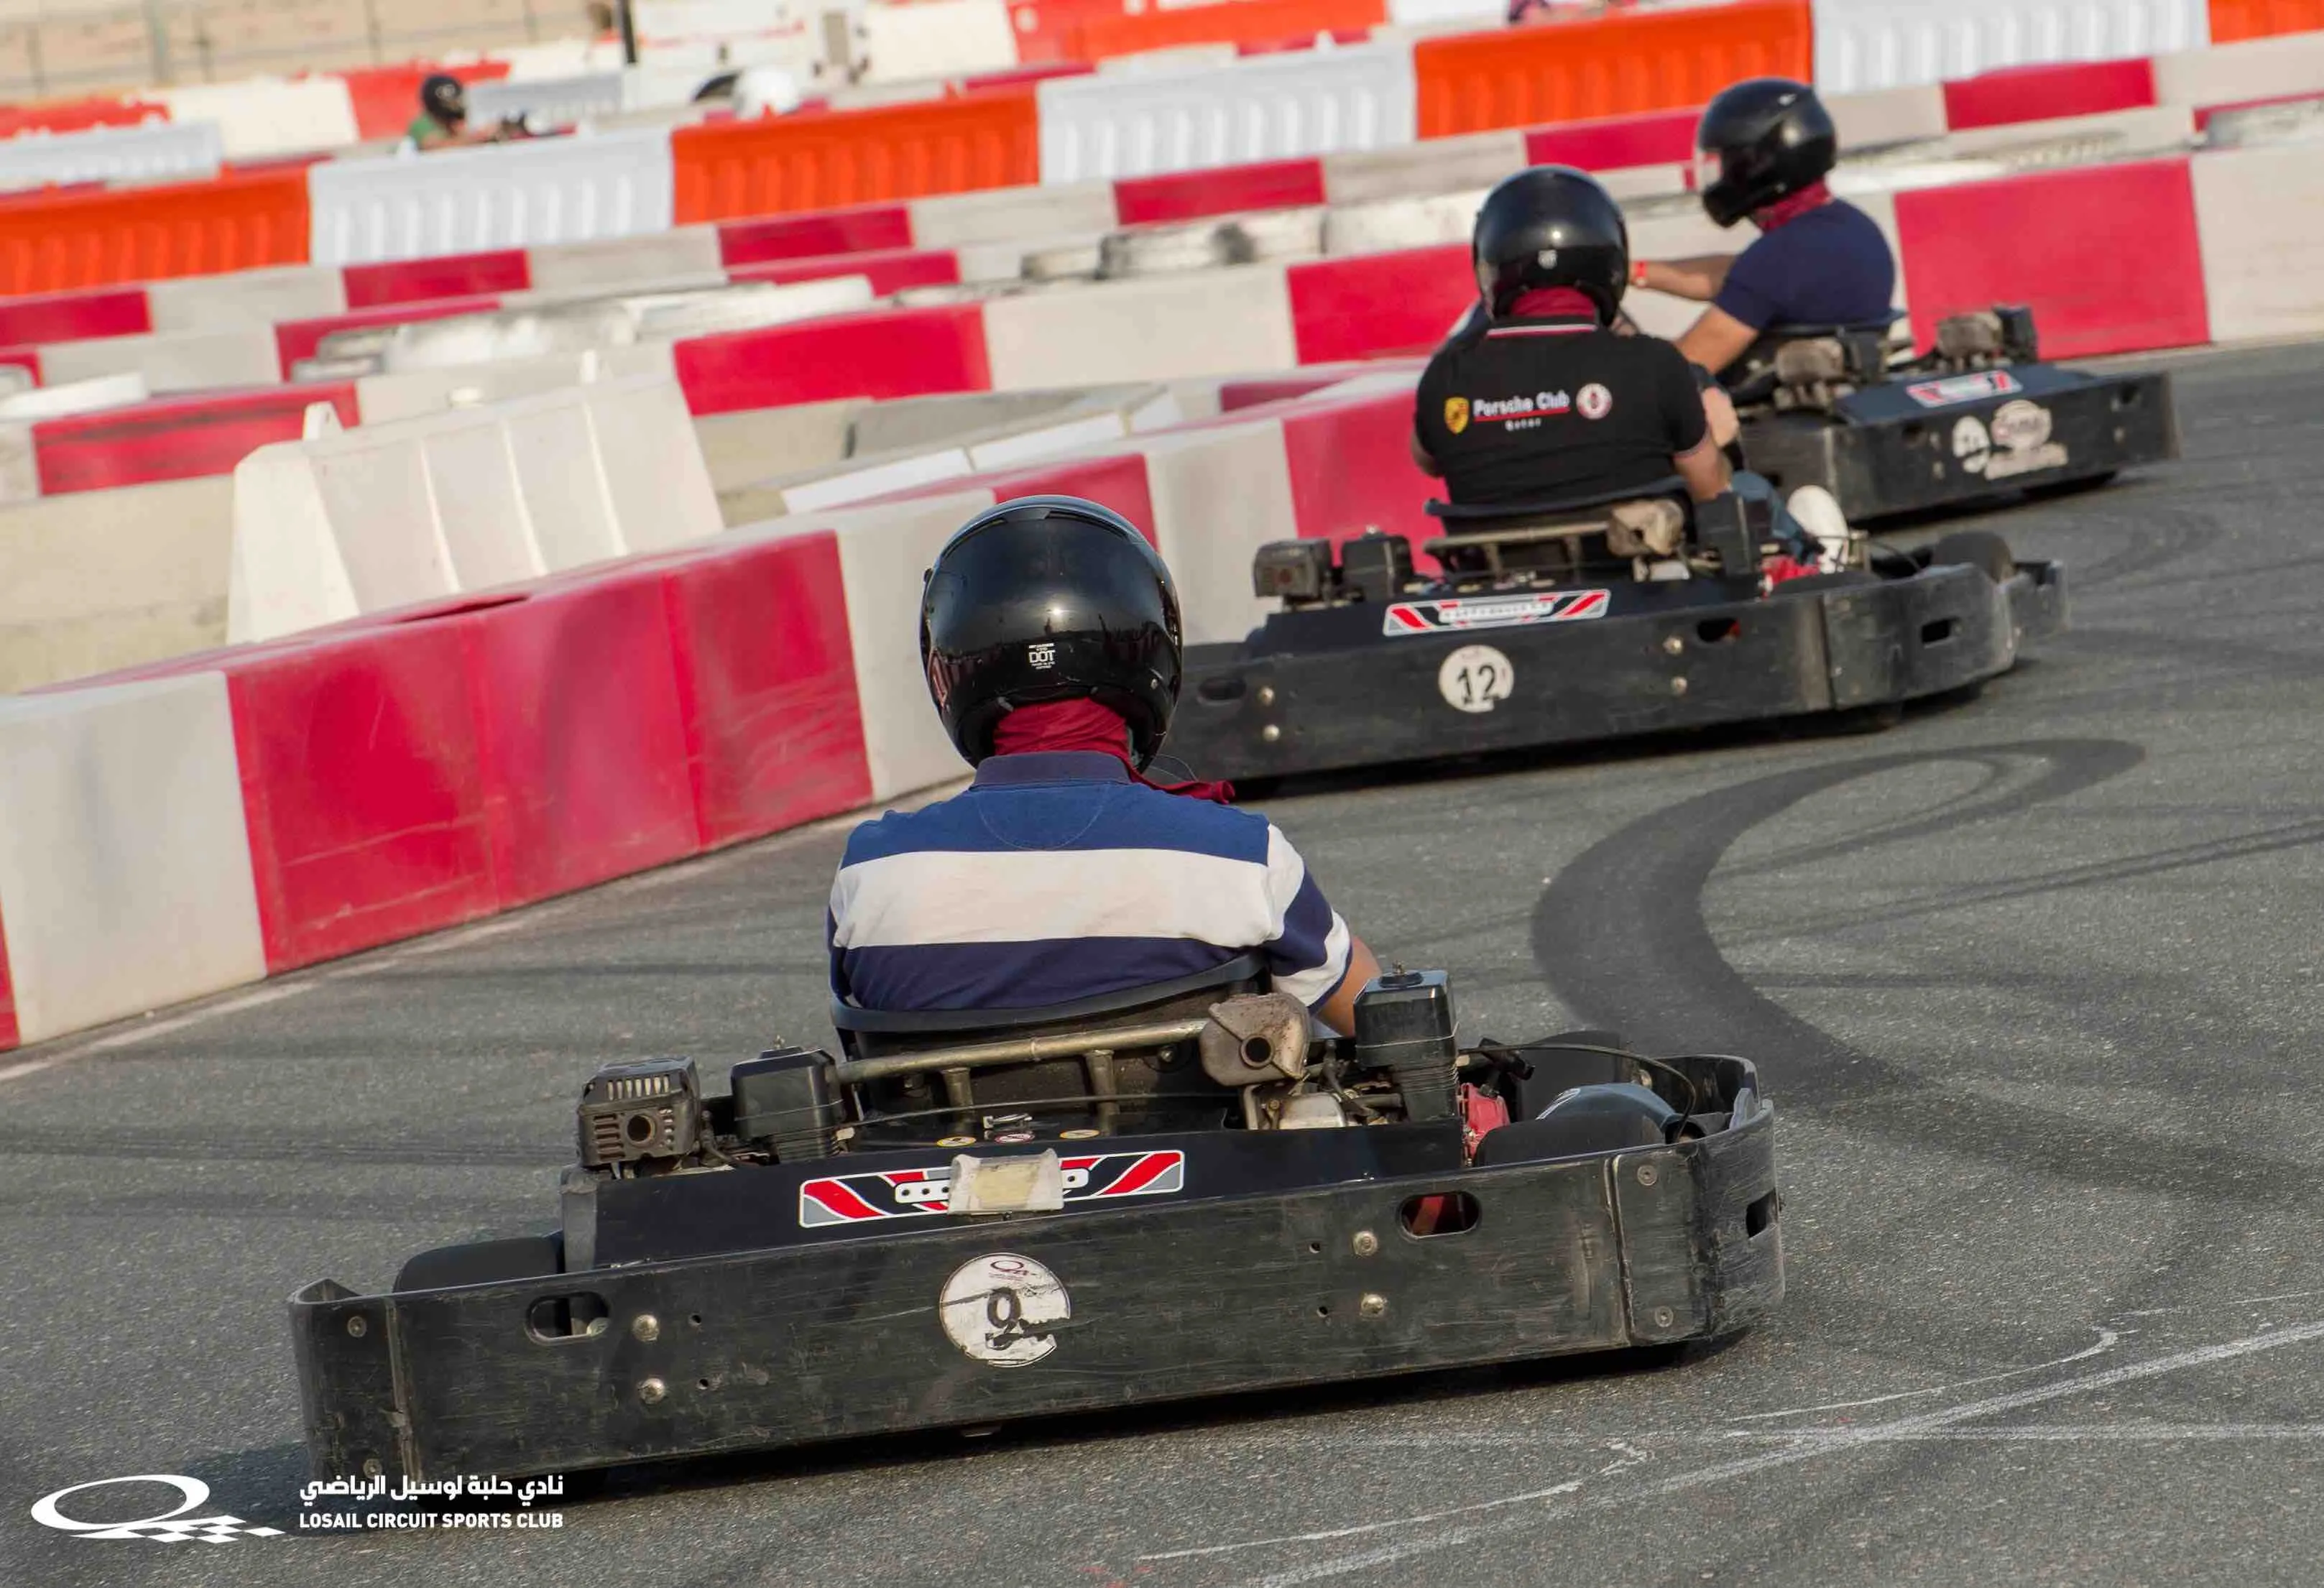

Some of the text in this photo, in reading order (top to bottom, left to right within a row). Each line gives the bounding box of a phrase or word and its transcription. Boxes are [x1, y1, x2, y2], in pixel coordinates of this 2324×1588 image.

[1473, 390, 1570, 417] Porsche Club
[1029, 650, 1056, 663] DOT
[1457, 664, 1502, 705] 12
[985, 1286, 1021, 1351] 9
